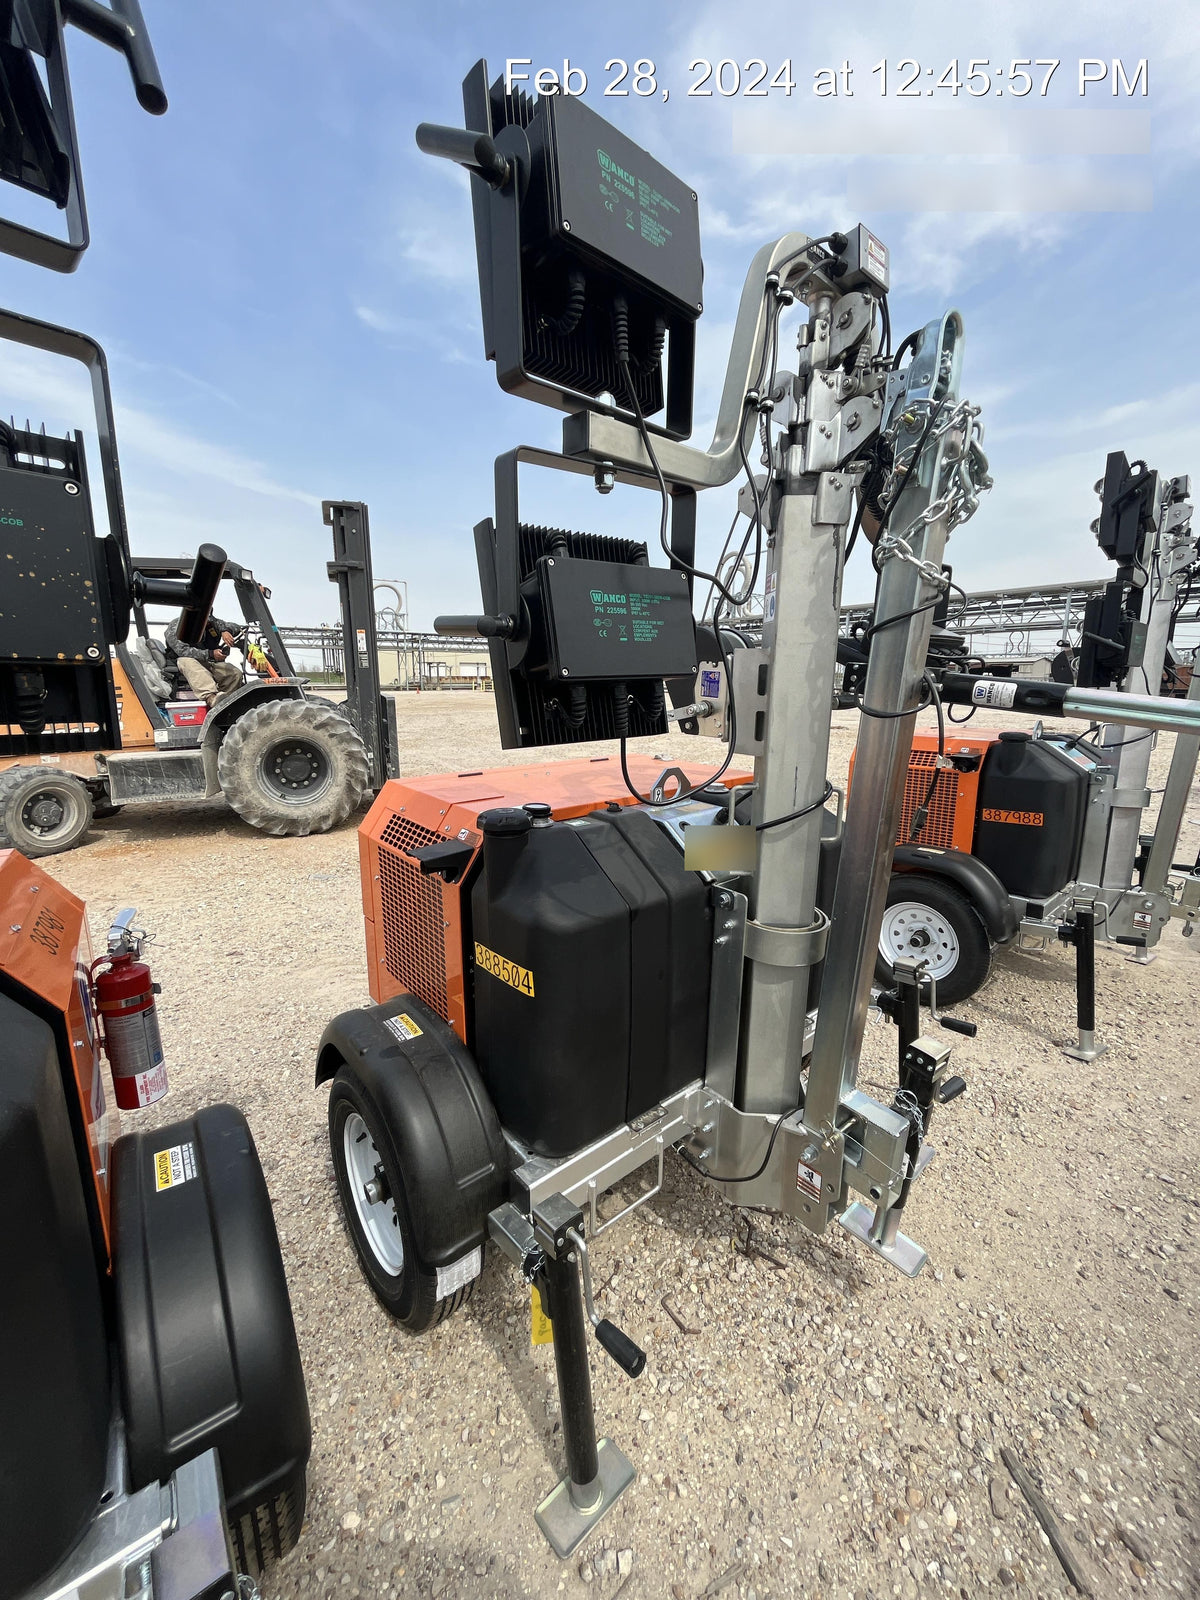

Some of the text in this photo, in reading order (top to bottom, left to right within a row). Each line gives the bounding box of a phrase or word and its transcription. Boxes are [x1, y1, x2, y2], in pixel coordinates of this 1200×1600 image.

[597, 148, 635, 187] WANCO
[601, 170, 611, 183] PN
[590, 590, 626, 604] WANCO
[986, 682, 995, 704] WANCO
[984, 809, 1042, 825] 387988
[476, 943, 533, 995] 388504
[171, 1150, 180, 1163] STEP
[158, 1152, 170, 1180] CAUTION
[172, 1168, 181, 1181] NOT
